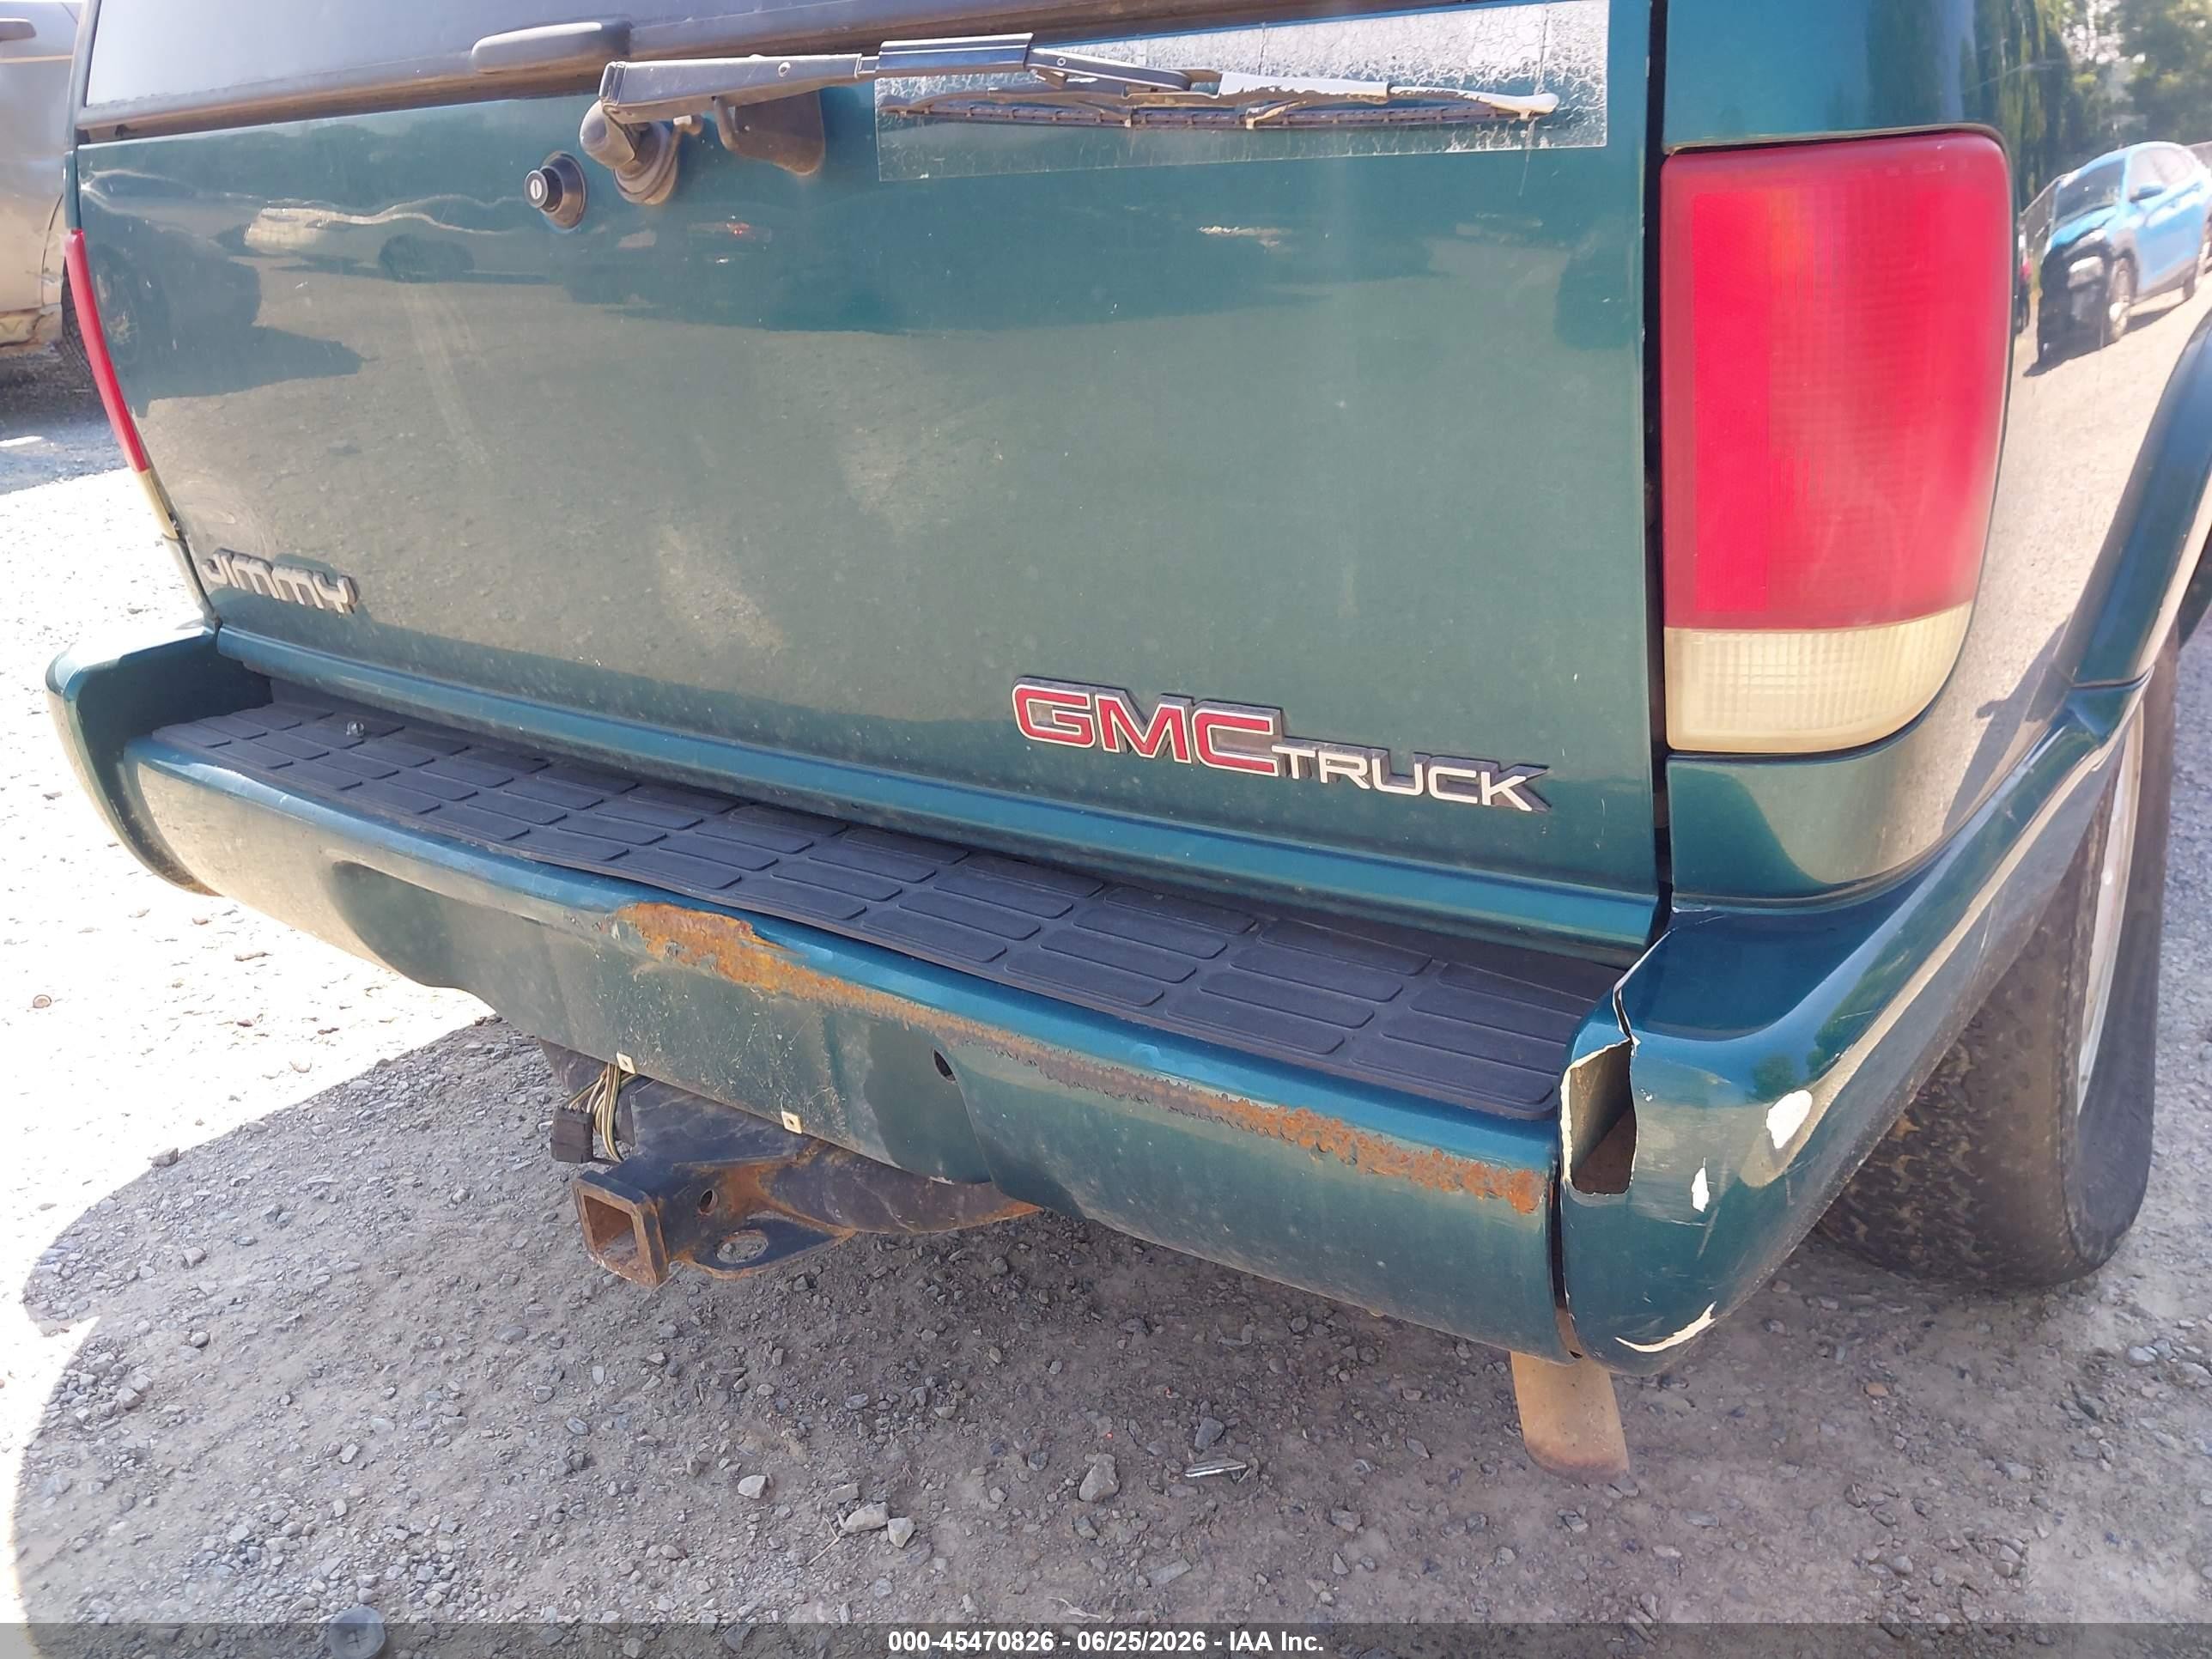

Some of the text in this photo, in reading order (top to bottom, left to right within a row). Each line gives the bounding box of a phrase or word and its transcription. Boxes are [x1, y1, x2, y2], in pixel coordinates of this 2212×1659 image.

[202, 551, 353, 614] JIMMY
[1012, 678, 1540, 812] GMC TRUCK
